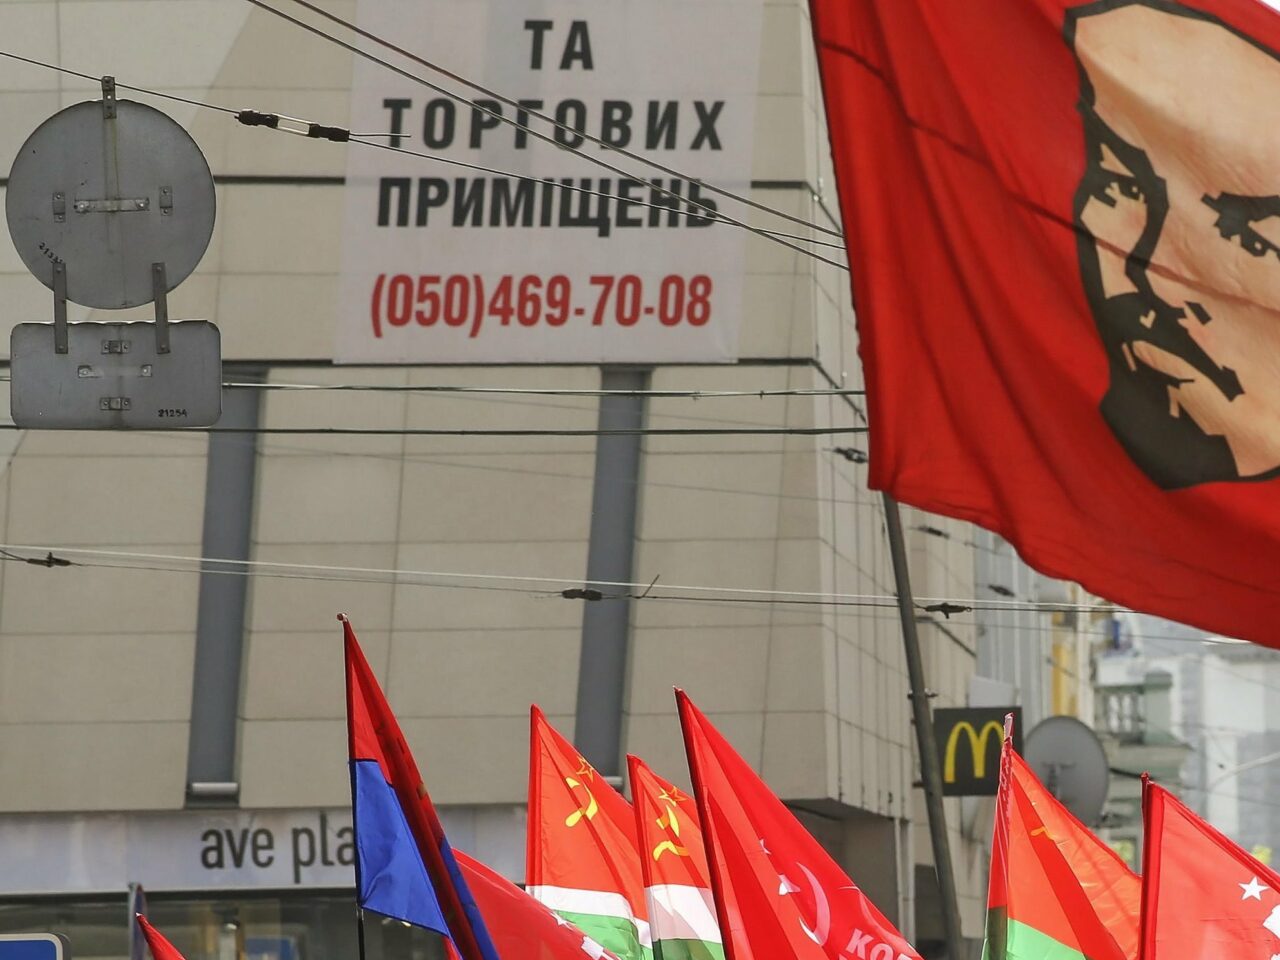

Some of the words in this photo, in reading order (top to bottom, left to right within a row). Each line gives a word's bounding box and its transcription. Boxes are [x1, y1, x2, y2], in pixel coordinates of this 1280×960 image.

[524, 20, 594, 71] ТА
[383, 98, 725, 151] ТОРГОВИХ
[377, 178, 718, 237] ПРИМІЩЕНЬ
[371, 274, 713, 338] (050)469-70-08
[201, 828, 274, 869] ave
